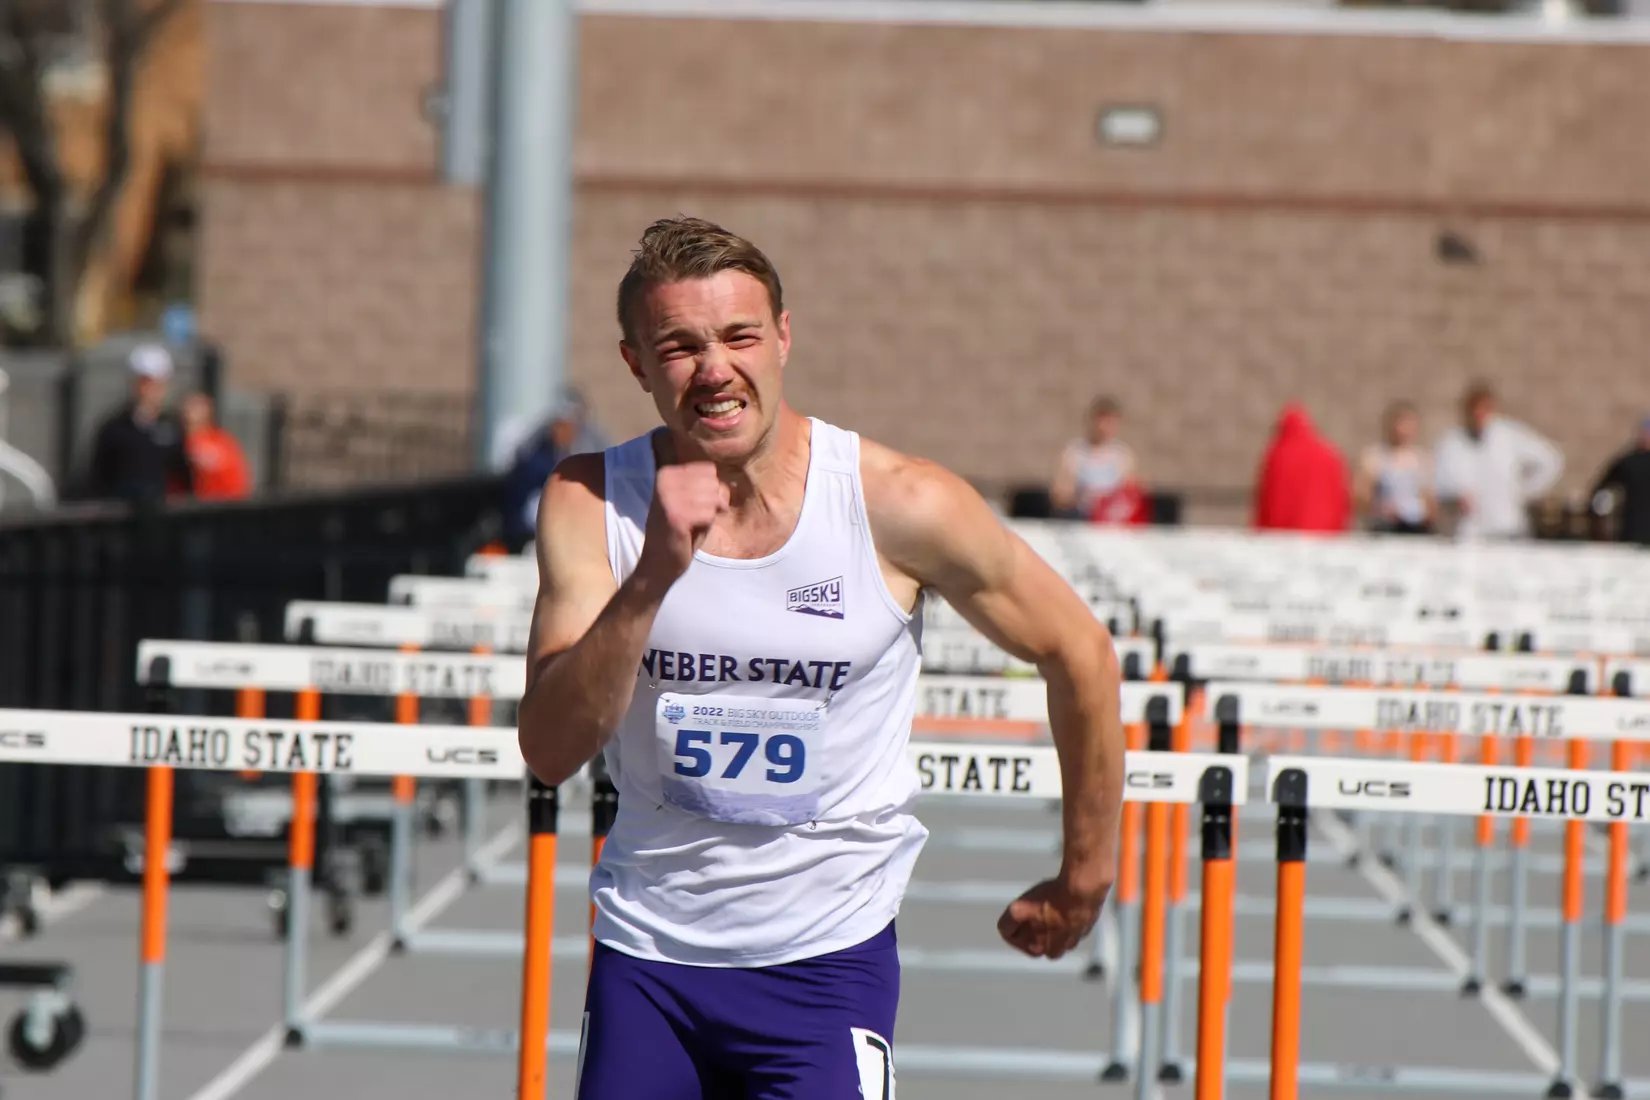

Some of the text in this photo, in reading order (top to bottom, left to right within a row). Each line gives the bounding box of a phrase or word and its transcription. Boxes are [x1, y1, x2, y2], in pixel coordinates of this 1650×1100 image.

[748, 657, 851, 691] STATE
[693, 706, 724, 717] 2022
[727, 708, 744, 718] BIG
[746, 709, 767, 720] SKY
[0, 726, 498, 769] CS IDAHO STATE UCS
[673, 729, 806, 784] 579
[918, 753, 1173, 792] STATE CS
[1339, 776, 1650, 818] UCS IDAHO ST
